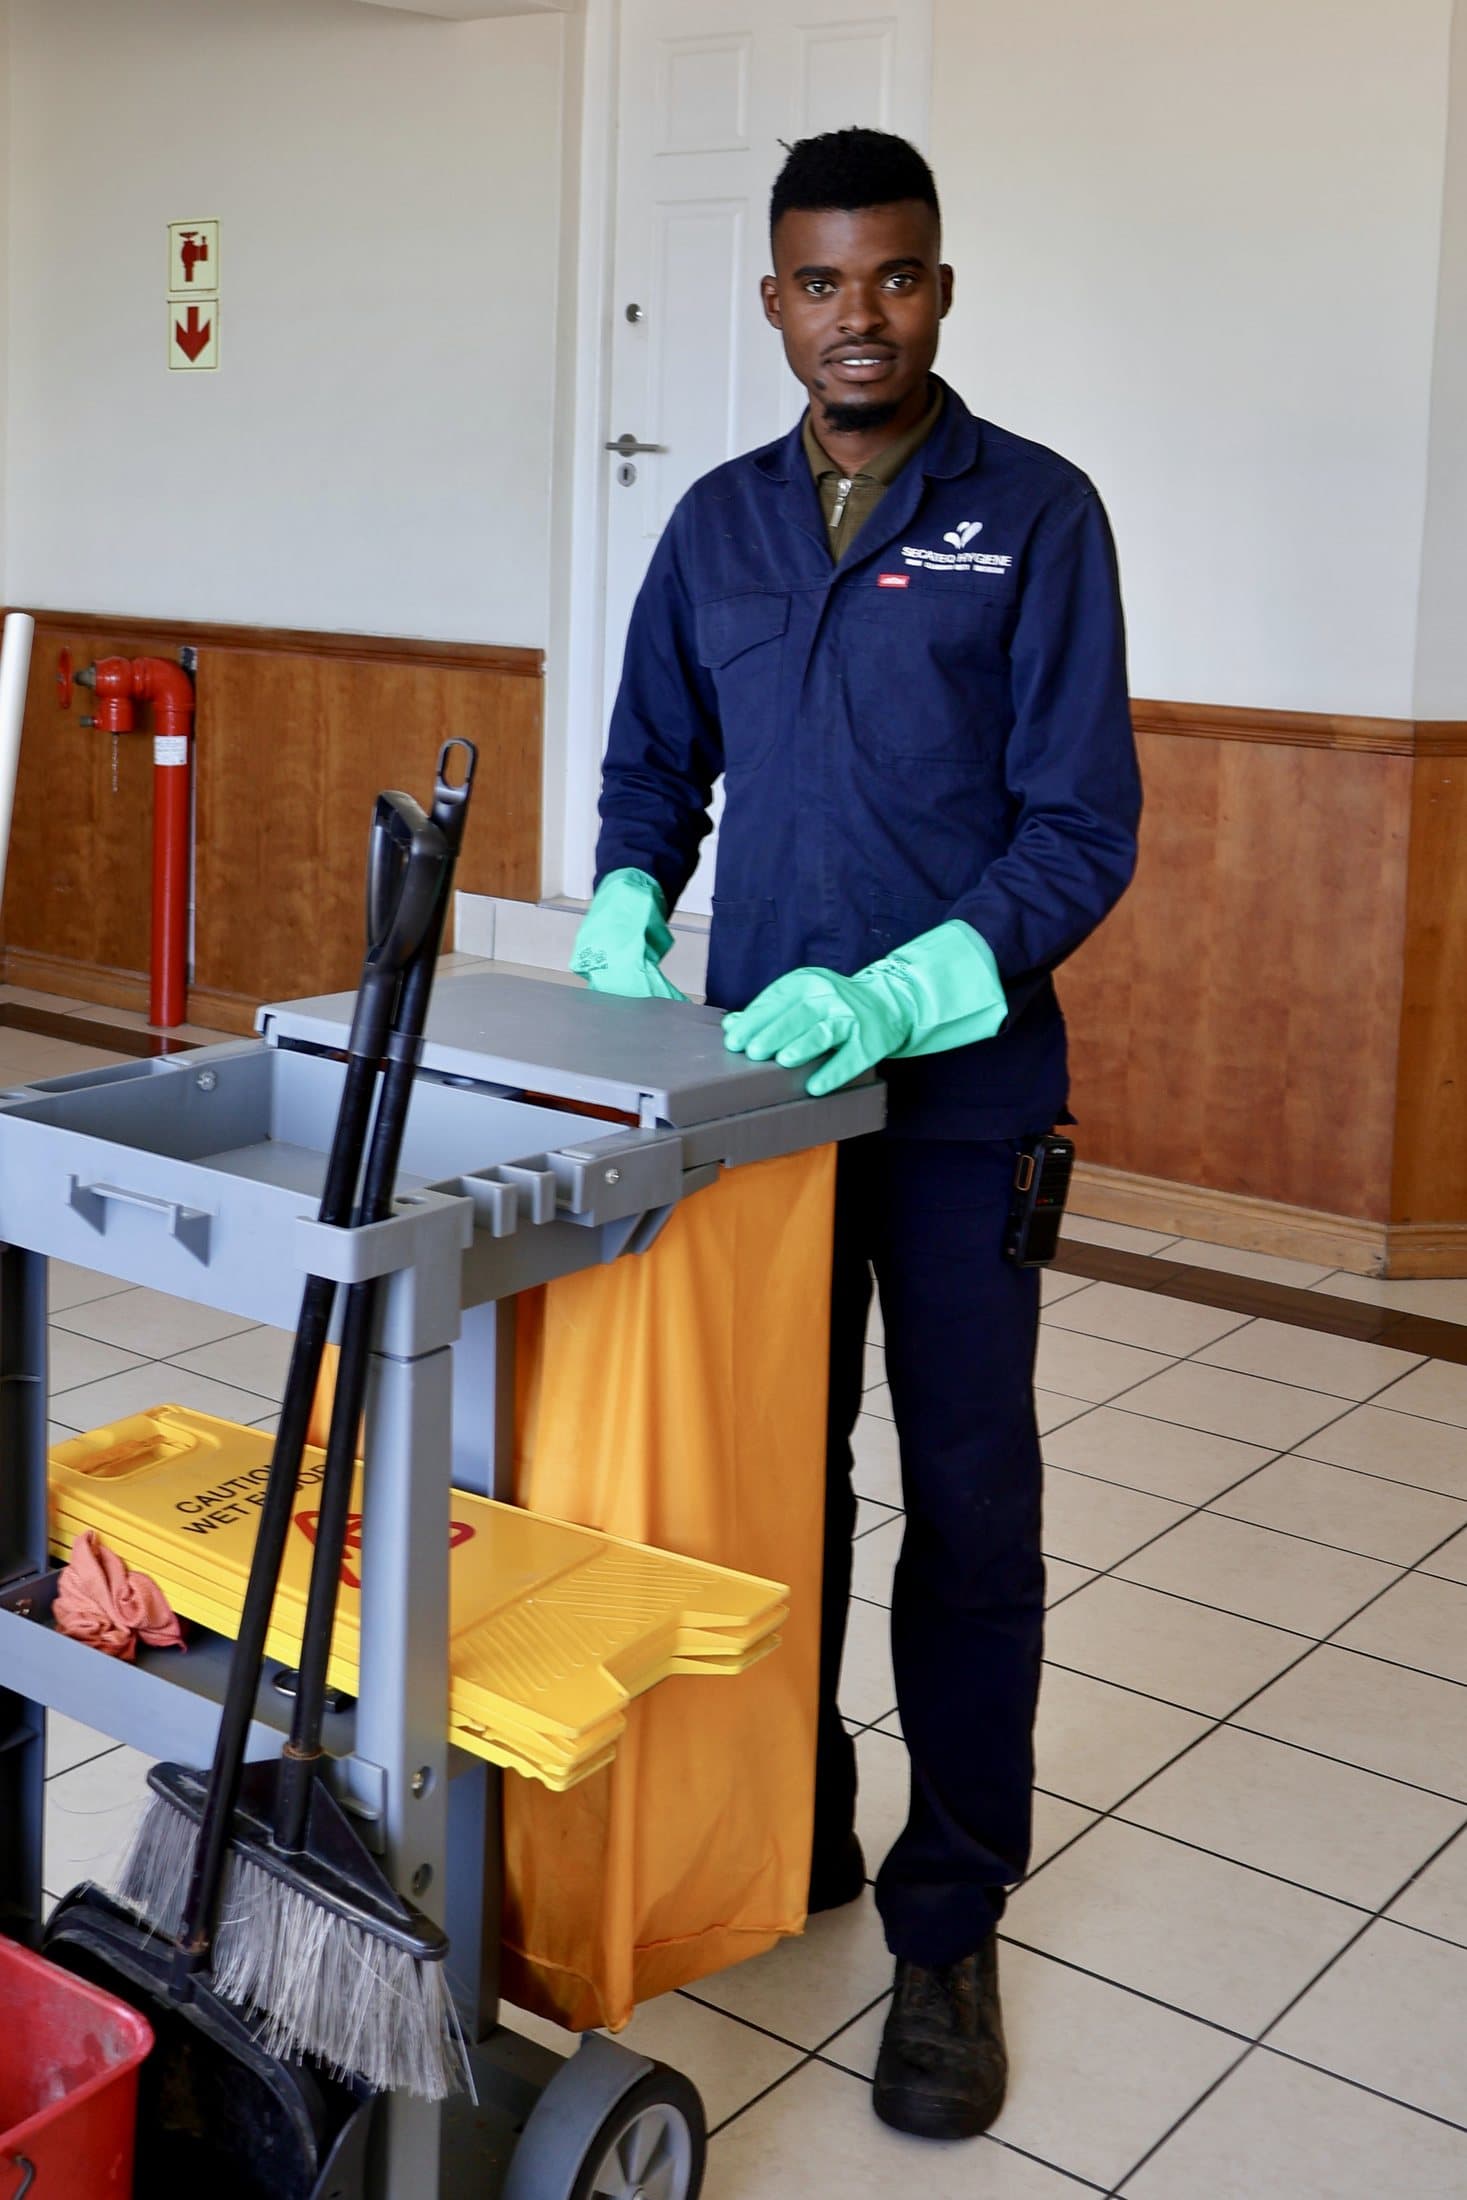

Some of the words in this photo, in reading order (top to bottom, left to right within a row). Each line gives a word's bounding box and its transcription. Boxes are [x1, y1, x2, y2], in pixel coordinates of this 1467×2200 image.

[956, 552, 1012, 567] HYGIENE
[176, 1464, 272, 1514] CAUTIO
[181, 1503, 251, 1535] WET
